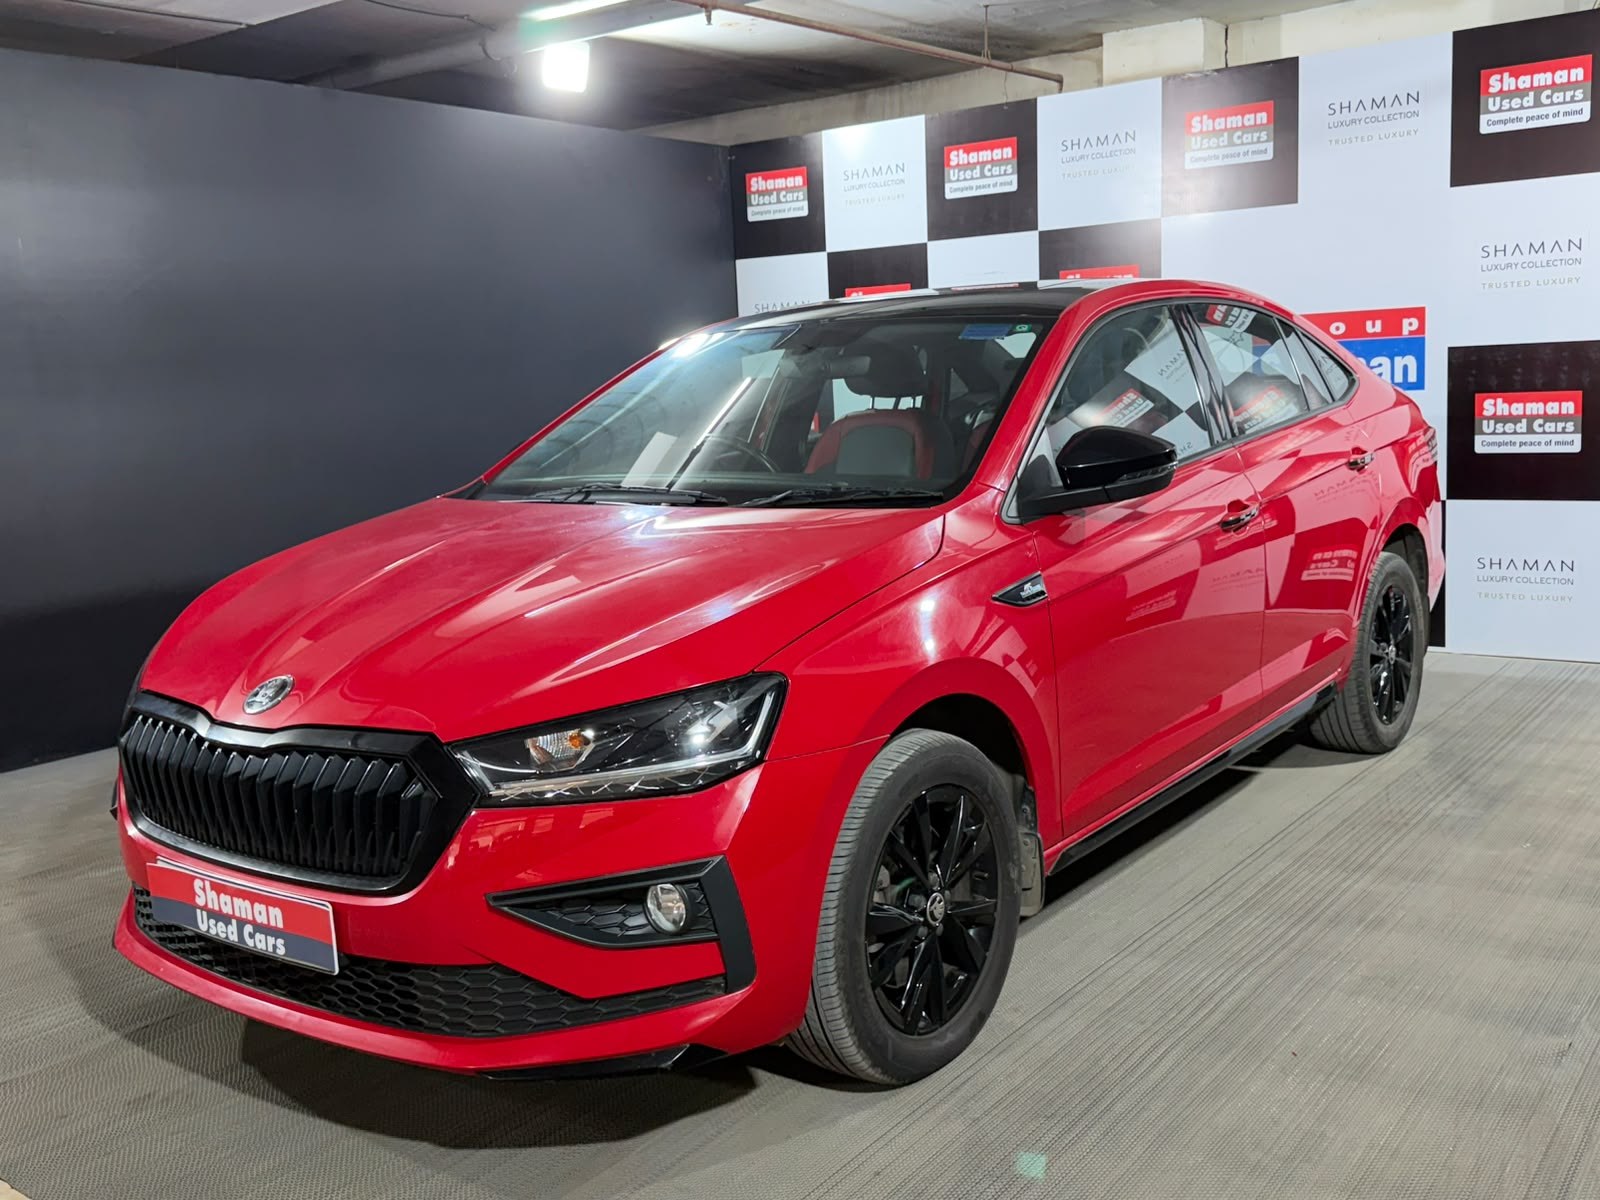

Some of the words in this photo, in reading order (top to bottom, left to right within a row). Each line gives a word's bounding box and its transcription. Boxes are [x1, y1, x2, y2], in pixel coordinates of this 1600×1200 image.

[1488, 67, 1584, 93] Shaman
[1327, 91, 1420, 116] SHAMAN
[1487, 91, 1534, 111] Used
[1540, 88, 1584, 105] Cars
[1191, 112, 1268, 133] Shaman
[1327, 117, 1362, 129] LUXURY
[1364, 110, 1420, 125] COLLECTION
[1486, 116, 1524, 127] Complete
[1525, 113, 1550, 123] peace
[1552, 110, 1561, 119] of
[1562, 108, 1584, 118] mind
[1061, 130, 1136, 152] SHAMAN
[1191, 132, 1228, 149] Used
[1233, 131, 1268, 144] Cars
[1328, 134, 1374, 146] TRUSTED
[1378, 128, 1419, 140] LUXURY
[949, 146, 1013, 166] Shaman
[1061, 153, 1090, 164] LUXURY
[1091, 147, 1136, 160] COLLECTION
[1242, 149, 1249, 157] of
[1250, 147, 1268, 156] mind
[843, 162, 905, 181] SHAMAN
[949, 165, 980, 181] Used
[984, 164, 1013, 177] Cars
[750, 175, 803, 192] Shaman
[750, 191, 777, 206] Used
[780, 190, 804, 202] Cars
[1480, 238, 1582, 259] SHAMAN
[1480, 262, 1519, 272] LUXURY
[1520, 257, 1582, 269] COLLECTION
[1481, 279, 1531, 290] TRUSTED
[1536, 276, 1581, 287] LUXURY
[1482, 398, 1575, 416] Shaman
[1482, 418, 1527, 434] Used
[1532, 418, 1575, 433] Cars
[1481, 439, 1517, 448] Complete
[1518, 440, 1542, 448] peace
[1544, 439, 1553, 447] of
[1554, 439, 1575, 447] mind
[1477, 557, 1574, 572] SHAMAN
[1477, 575, 1514, 583] LUXURY
[1515, 576, 1574, 586] COLLECTION
[1477, 591, 1526, 601] TRUSTED
[1530, 594, 1574, 603] LUXURY
[193, 878, 284, 929] Shaman
[196, 908, 238, 942] Used
[243, 923, 286, 956] Cars
